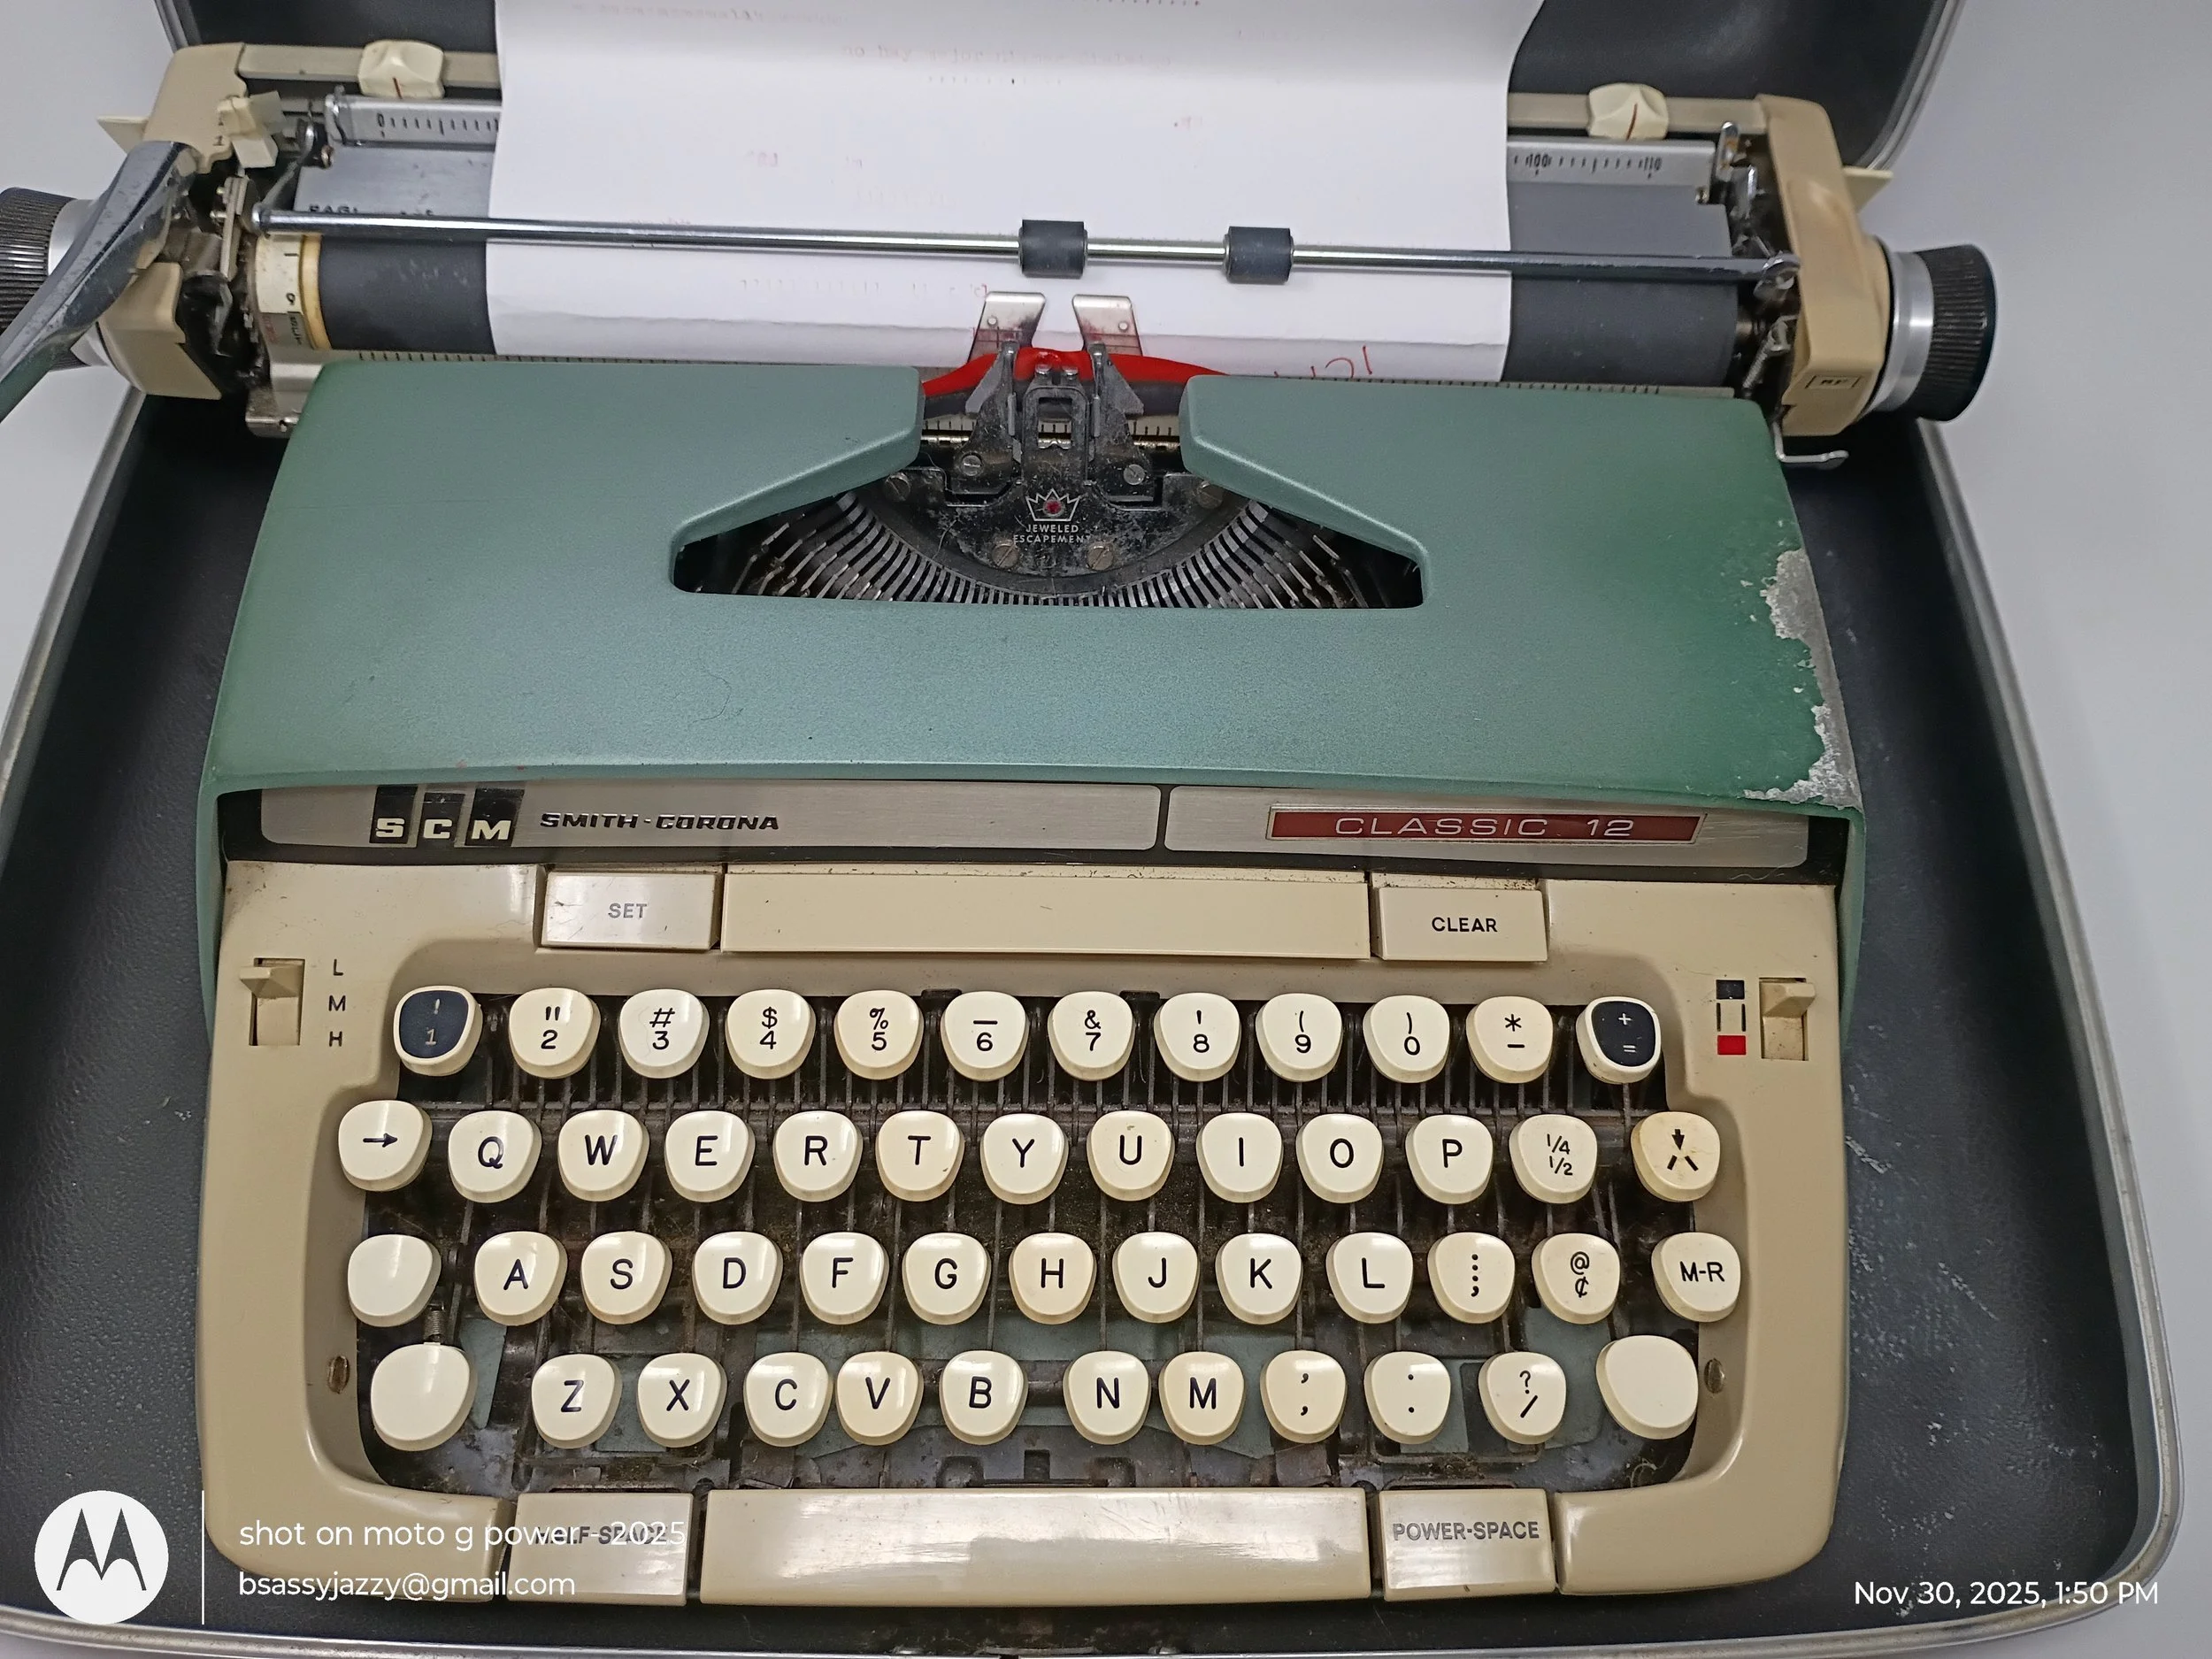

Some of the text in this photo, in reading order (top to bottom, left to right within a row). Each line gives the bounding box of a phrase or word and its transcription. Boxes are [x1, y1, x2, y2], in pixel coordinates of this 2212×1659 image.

[1025, 524, 1079, 534] JEWELED
[376, 818, 511, 841] SCM
[1334, 818, 1634, 837] CLASSIC 12
[608, 903, 647, 918] SET
[1432, 918, 1497, 932] CLEAR
[334, 959, 343, 976] L
[329, 995, 345, 1011] M
[649, 1008, 675, 1027] #
[762, 1007, 777, 1029] $
[870, 1008, 888, 1030] %
[1085, 1010, 1101, 1029] &
[329, 1032, 342, 1047] H
[426, 1029, 436, 1045] 1
[541, 1030, 557, 1049] 2
[653, 1031, 669, 1049] 3
[760, 1031, 776, 1049] 4
[872, 1032, 887, 1050] 5
[977, 1033, 993, 1051] 6
[1086, 1033, 1101, 1051] 7
[1194, 1034, 1210, 1053] 8
[1295, 1034, 1311, 1053] 9
[1404, 1036, 1420, 1056] 0
[478, 1137, 503, 1169] Q
[585, 1135, 615, 1165] W
[695, 1136, 718, 1166] E
[804, 1136, 827, 1165] R
[908, 1135, 931, 1165] T
[1012, 1139, 1034, 1168] Y
[1119, 1135, 1141, 1165] U
[1330, 1139, 1354, 1168] O
[1442, 1139, 1462, 1168] P
[503, 1259, 528, 1290] A
[611, 1259, 633, 1289] S
[723, 1258, 746, 1288] D
[833, 1257, 853, 1288] F
[935, 1258, 957, 1289] G
[1041, 1258, 1064, 1288] H
[1148, 1258, 1166, 1287] J
[1250, 1258, 1272, 1289] K
[1362, 1258, 1385, 1288] L
[1571, 1252, 1589, 1274] @
[1680, 1262, 1724, 1281] M-R
[865, 1377, 890, 1409] V
[969, 1377, 991, 1409] B
[1097, 1378, 1119, 1409] N
[1190, 1378, 1216, 1409] M
[1520, 1371, 1531, 1394] ?
[561, 1380, 583, 1412] Z
[666, 1379, 689, 1411] X
[775, 1379, 797, 1410] C
[1392, 1520, 1540, 1541] POWER-SPACE
